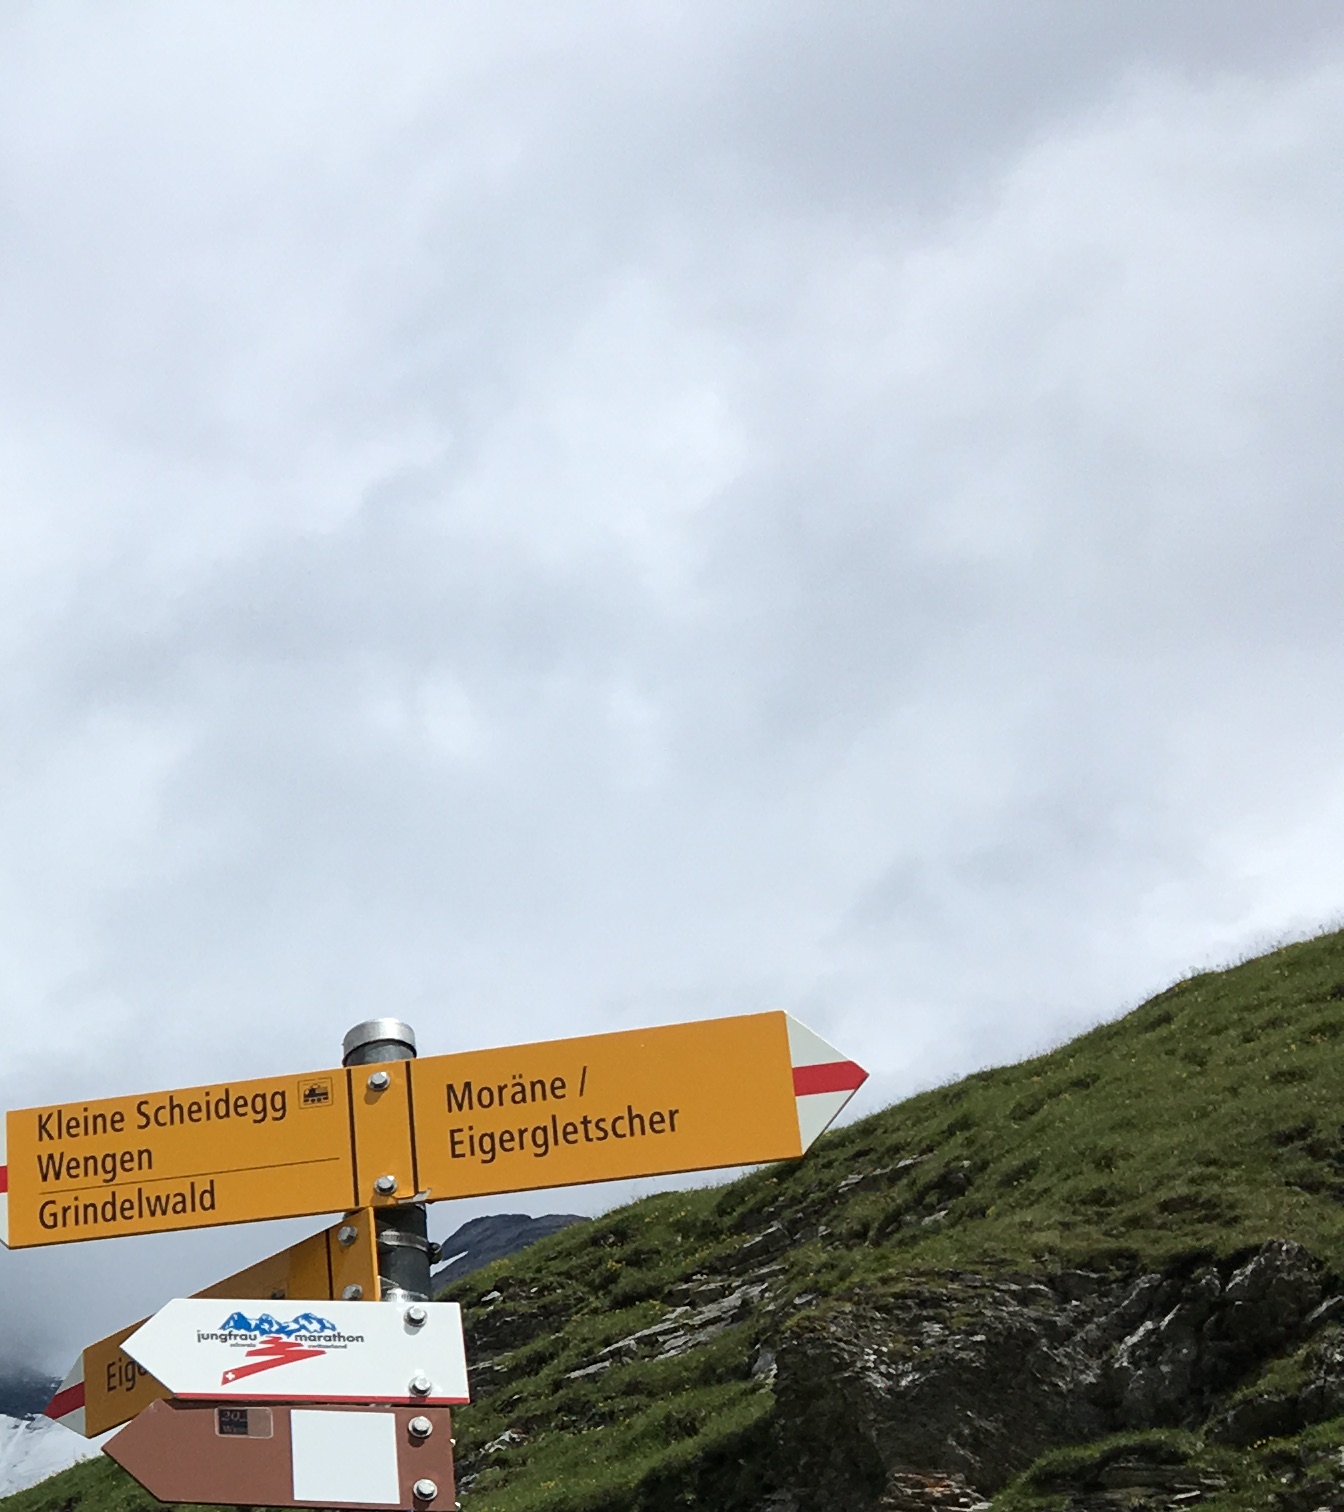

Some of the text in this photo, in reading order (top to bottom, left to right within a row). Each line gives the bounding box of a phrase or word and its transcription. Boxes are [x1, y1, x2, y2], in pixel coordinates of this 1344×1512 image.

[37, 1087, 287, 1142] Kleine Scheidegg
[445, 1065, 588, 1114] Moräne /
[448, 1104, 680, 1165] Eigergletscher
[36, 1147, 153, 1184] Wengen
[38, 1179, 216, 1230] Grindelwald
[196, 1329, 365, 1343] jungfrau marathon
